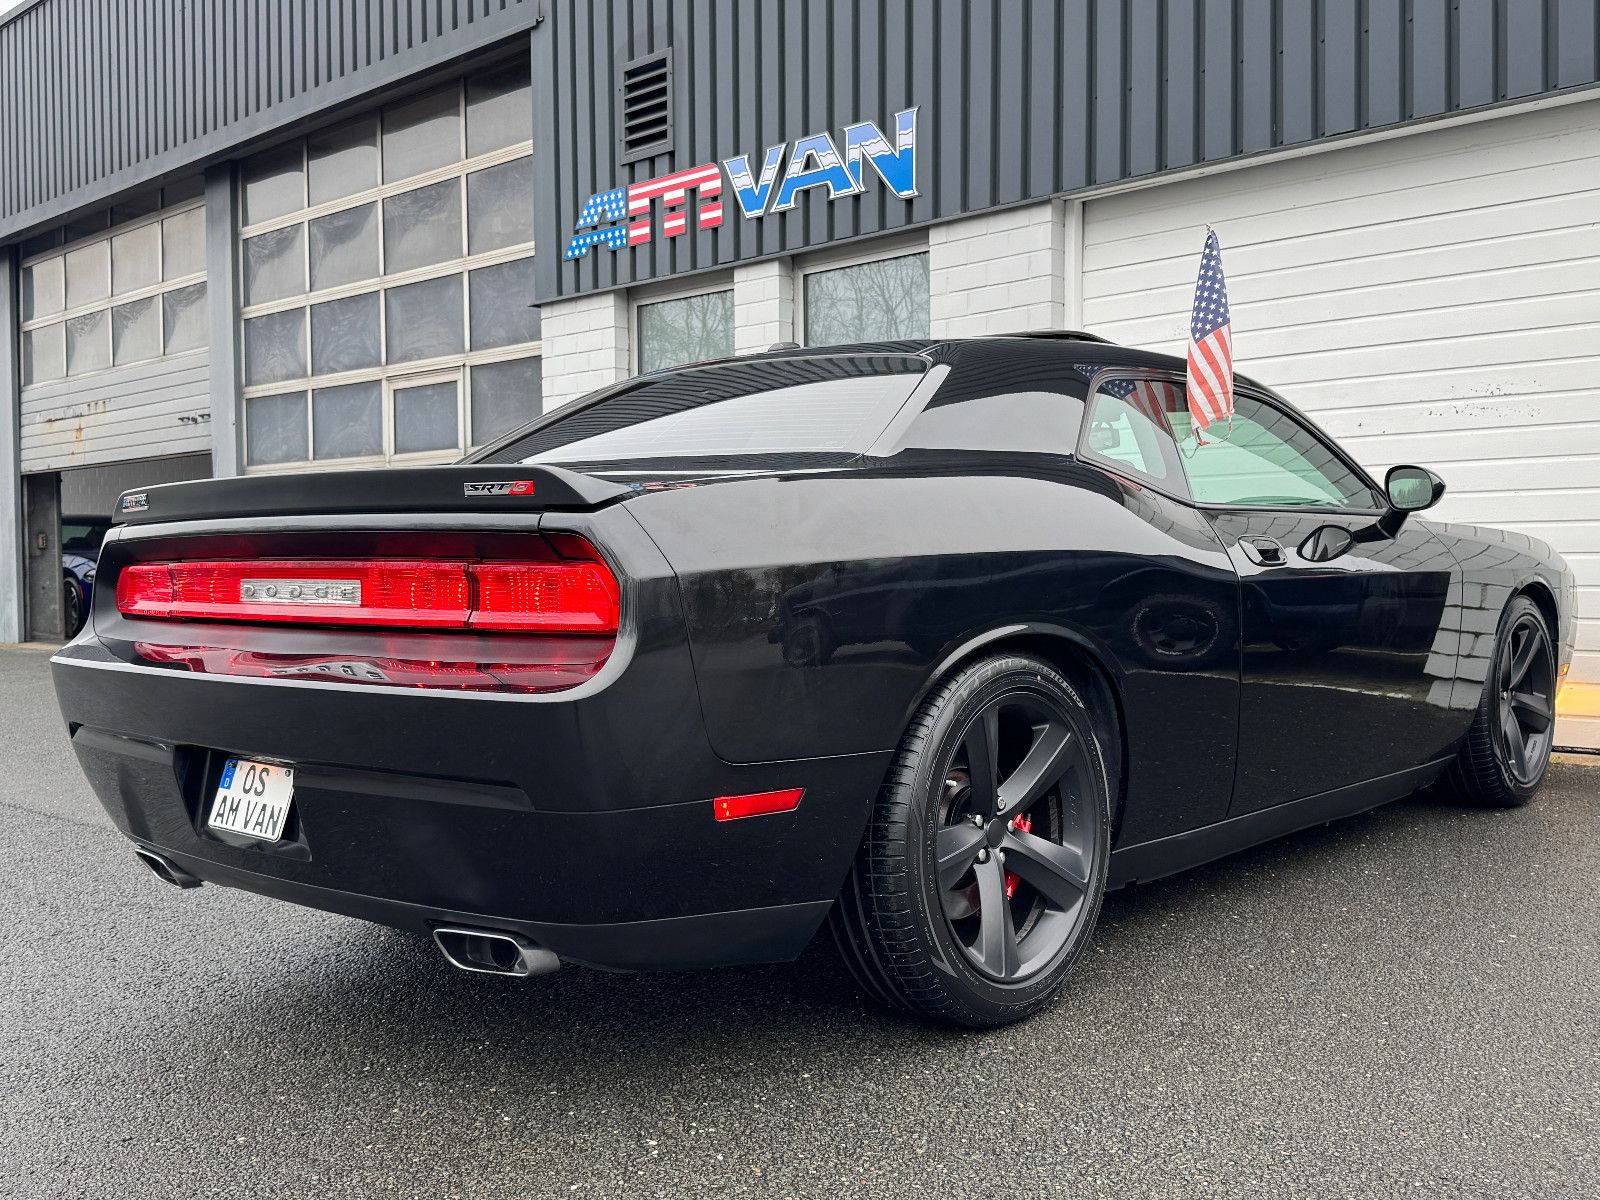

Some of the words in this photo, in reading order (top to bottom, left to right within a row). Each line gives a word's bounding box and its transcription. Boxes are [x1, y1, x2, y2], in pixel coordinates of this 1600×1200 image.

[242, 584, 357, 599] DODGE
[243, 764, 270, 797] OS
[213, 795, 242, 827] AM
[243, 799, 283, 837] VAN
